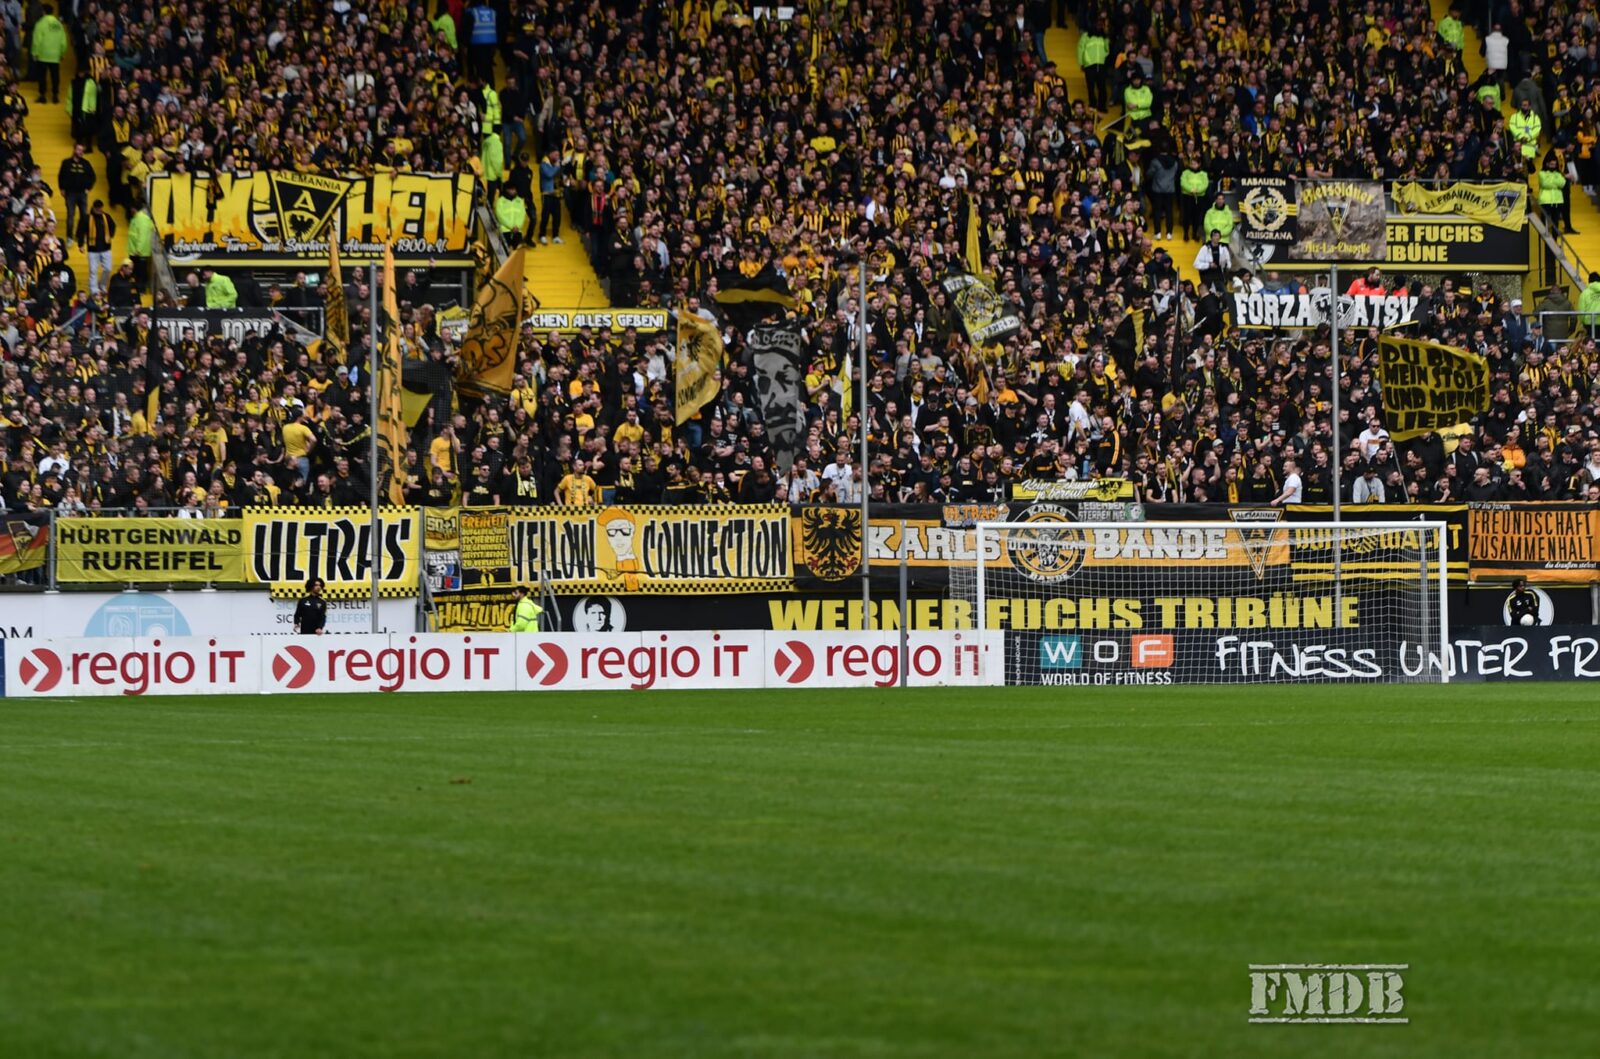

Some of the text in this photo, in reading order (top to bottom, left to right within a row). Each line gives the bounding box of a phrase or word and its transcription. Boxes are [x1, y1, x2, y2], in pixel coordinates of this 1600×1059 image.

[275, 171, 341, 190] ALEMANNIA
[397, 238, 426, 253] 1900
[1414, 224, 1485, 243] FUCHS
[521, 313, 665, 328] CHEN ALLES GEBEN!
[1233, 292, 1420, 328] FORZA ATSV
[1381, 341, 1421, 365] DU
[1384, 362, 1486, 390] MEIN STOLZ
[1384, 386, 1486, 412] UND MEINE
[60, 525, 242, 545] HÜRTGENWALD
[1472, 510, 1592, 536] FREUNDSCHAFT
[253, 518, 411, 582] ULTRAS
[510, 519, 595, 582] YELLOW
[642, 517, 788, 580] CONNECTION
[868, 526, 1229, 560] KARLS BANDE
[1470, 535, 1594, 560] ZUSAMMENHALT
[82, 551, 223, 571] RUREIFEL
[768, 591, 1360, 631] WERNER FUCHS TRIBÜNE
[72, 639, 195, 696] regio
[328, 636, 450, 692] regio
[581, 634, 700, 689] regio
[826, 633, 942, 687] regio
[1215, 635, 1382, 679] FITNESS
[1399, 637, 1533, 678] UNTER
[1041, 671, 1172, 686] WORLD OF FITNESS
